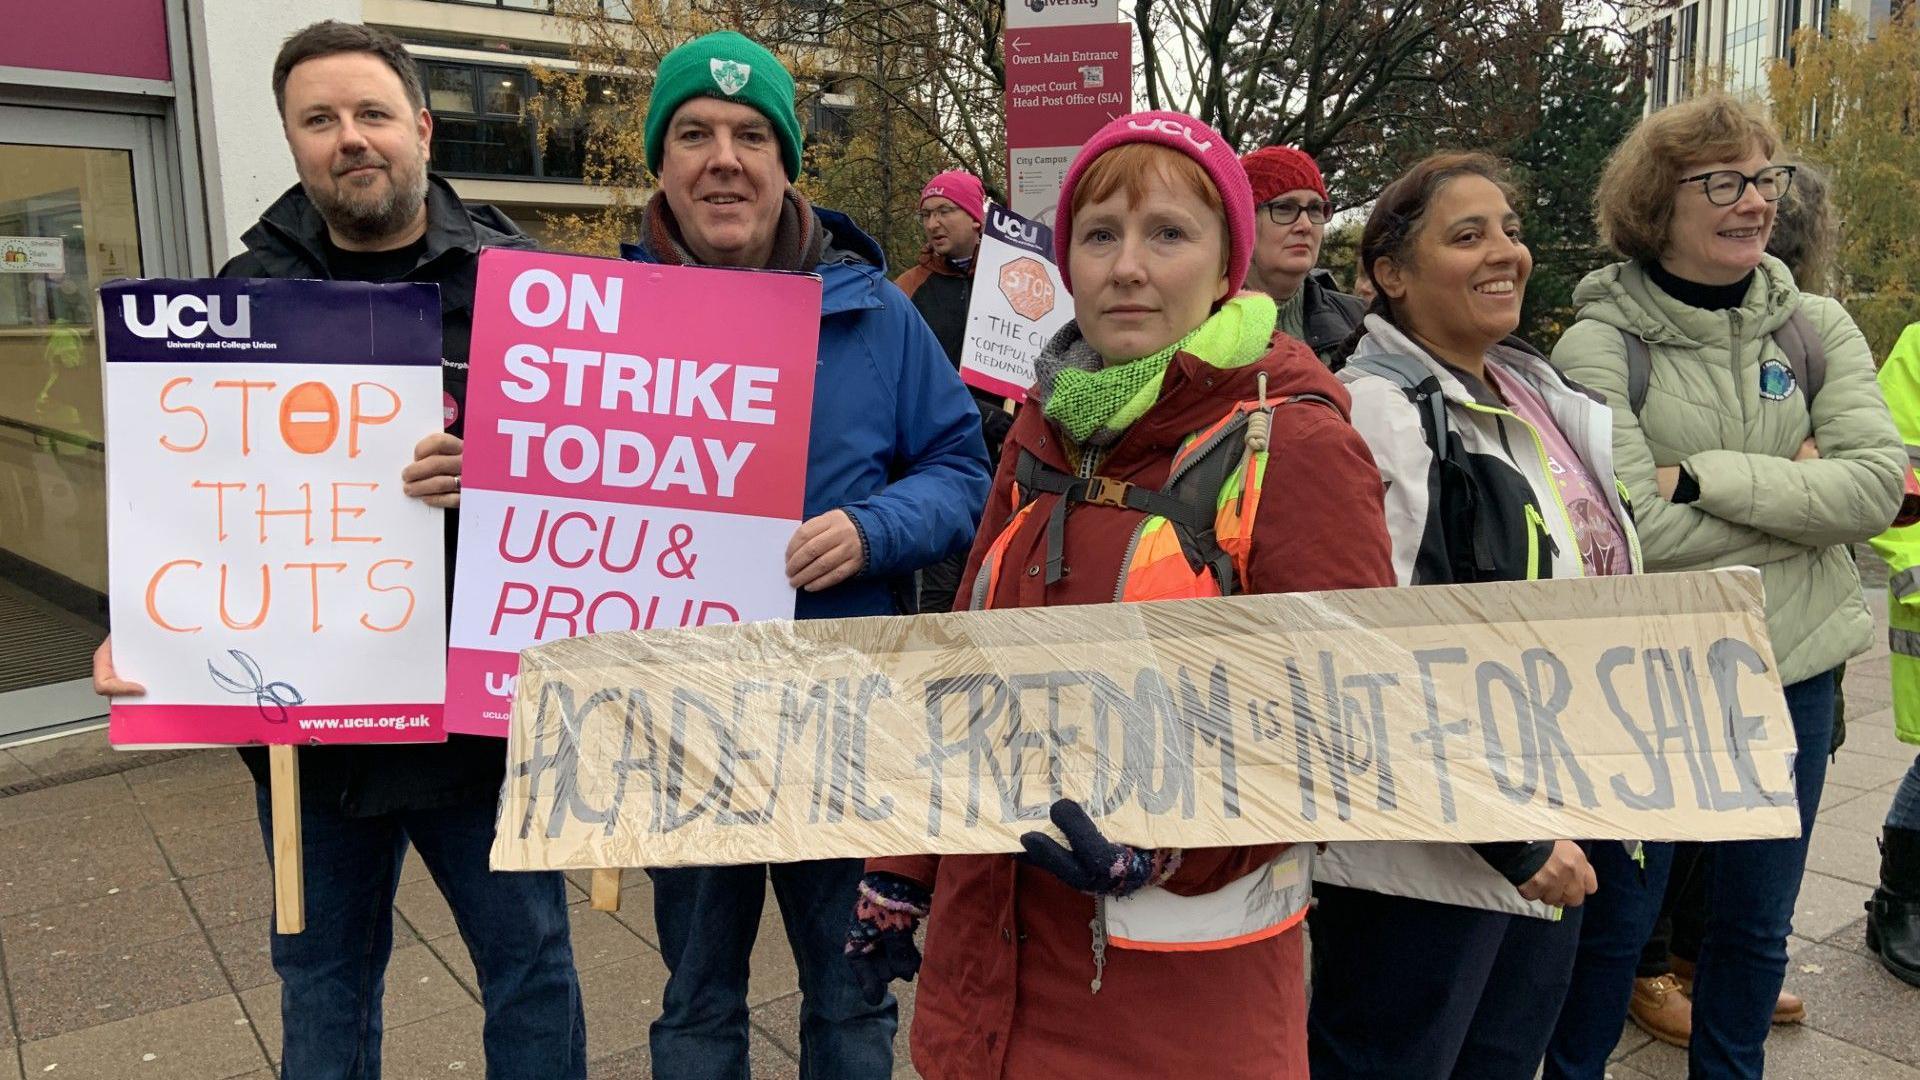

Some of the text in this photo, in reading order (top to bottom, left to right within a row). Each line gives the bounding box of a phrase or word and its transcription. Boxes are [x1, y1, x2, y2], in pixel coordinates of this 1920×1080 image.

[1012, 51, 1119, 65] Owen Main Entrance
[1012, 81, 1077, 96] Aspect Court
[1013, 92, 1123, 107] Head Post Office (SIA)
[1128, 118, 1212, 153] UCU
[1016, 155, 1068, 167] City Campus
[993, 210, 1038, 244] UCU
[508, 268, 624, 334] ON
[1007, 271, 1053, 303] STOP
[122, 294, 250, 339] UCU
[988, 315, 1023, 341] THE
[167, 341, 277, 350] University and College Union
[500, 344, 780, 425] STRIKE
[159, 377, 402, 458] STOP
[498, 418, 756, 498] TODAY
[192, 480, 382, 545] THE
[498, 506, 698, 580] UCU &
[145, 559, 415, 633] CUTS
[299, 714, 430, 730] www.ucu.org.uk
[514, 672, 894, 839] ACADEMIC
[915, 657, 1240, 838] FREEDOM
[1411, 647, 1601, 824] FOR
[1595, 637, 1800, 812] SALE
